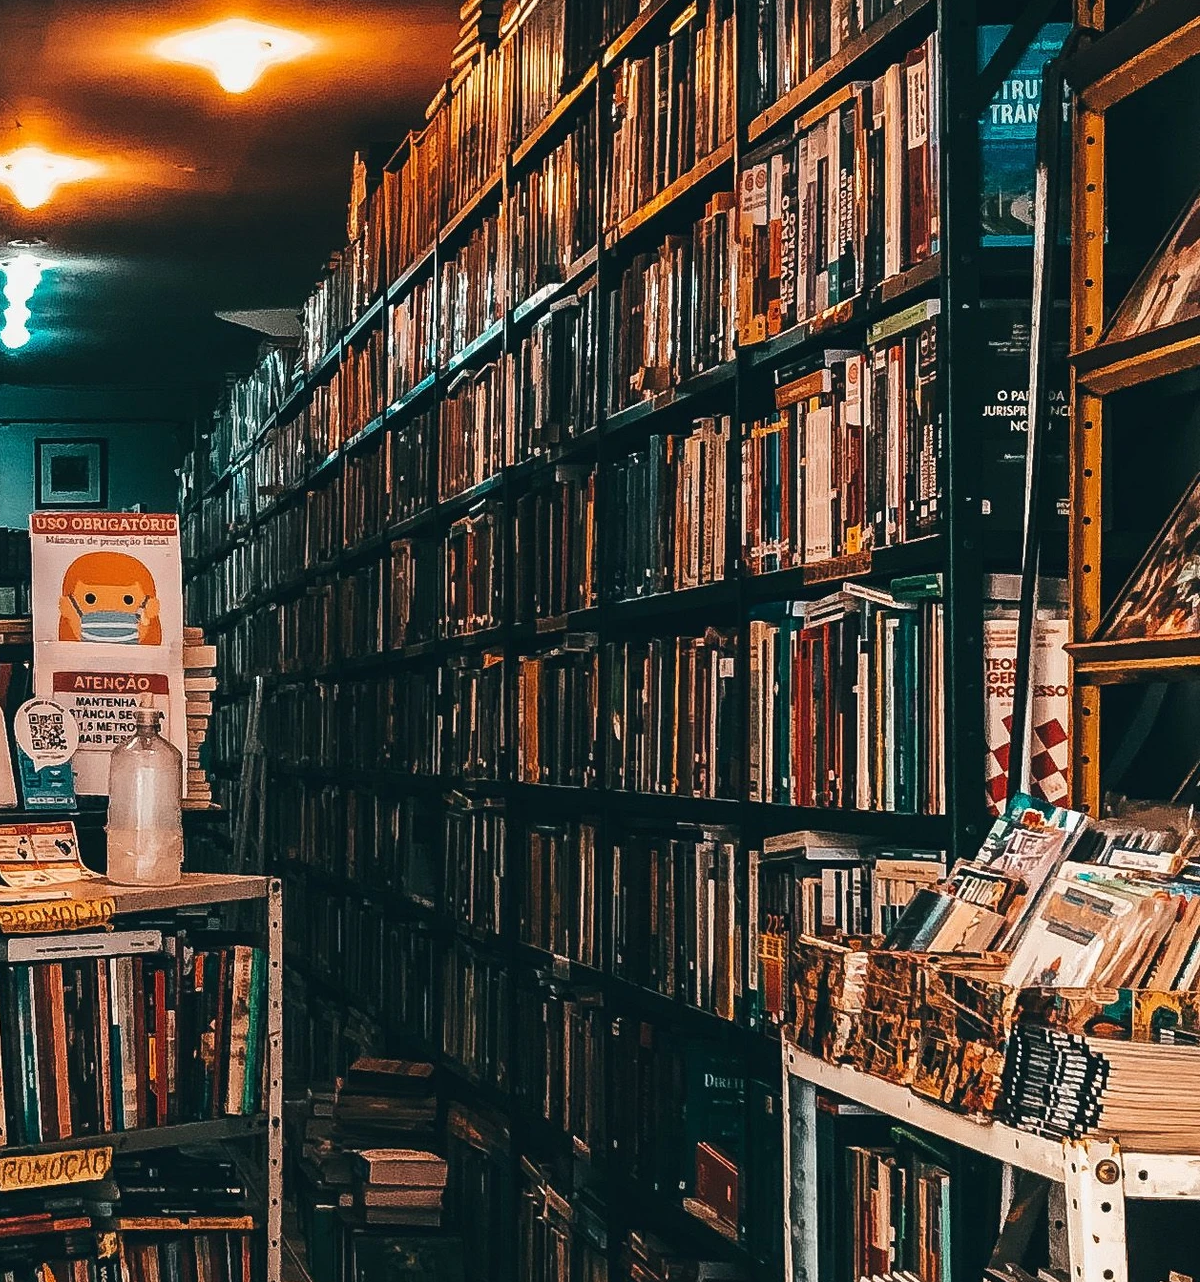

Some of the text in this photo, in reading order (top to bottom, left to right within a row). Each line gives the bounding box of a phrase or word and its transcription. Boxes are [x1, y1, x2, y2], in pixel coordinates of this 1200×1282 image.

[36, 514, 178, 532] USO OBRIGATÓRIO
[45, 535, 170, 548] Máscara de proteção facial
[73, 674, 151, 694] ATENÇÃO
[75, 696, 137, 707] MANTENHA
